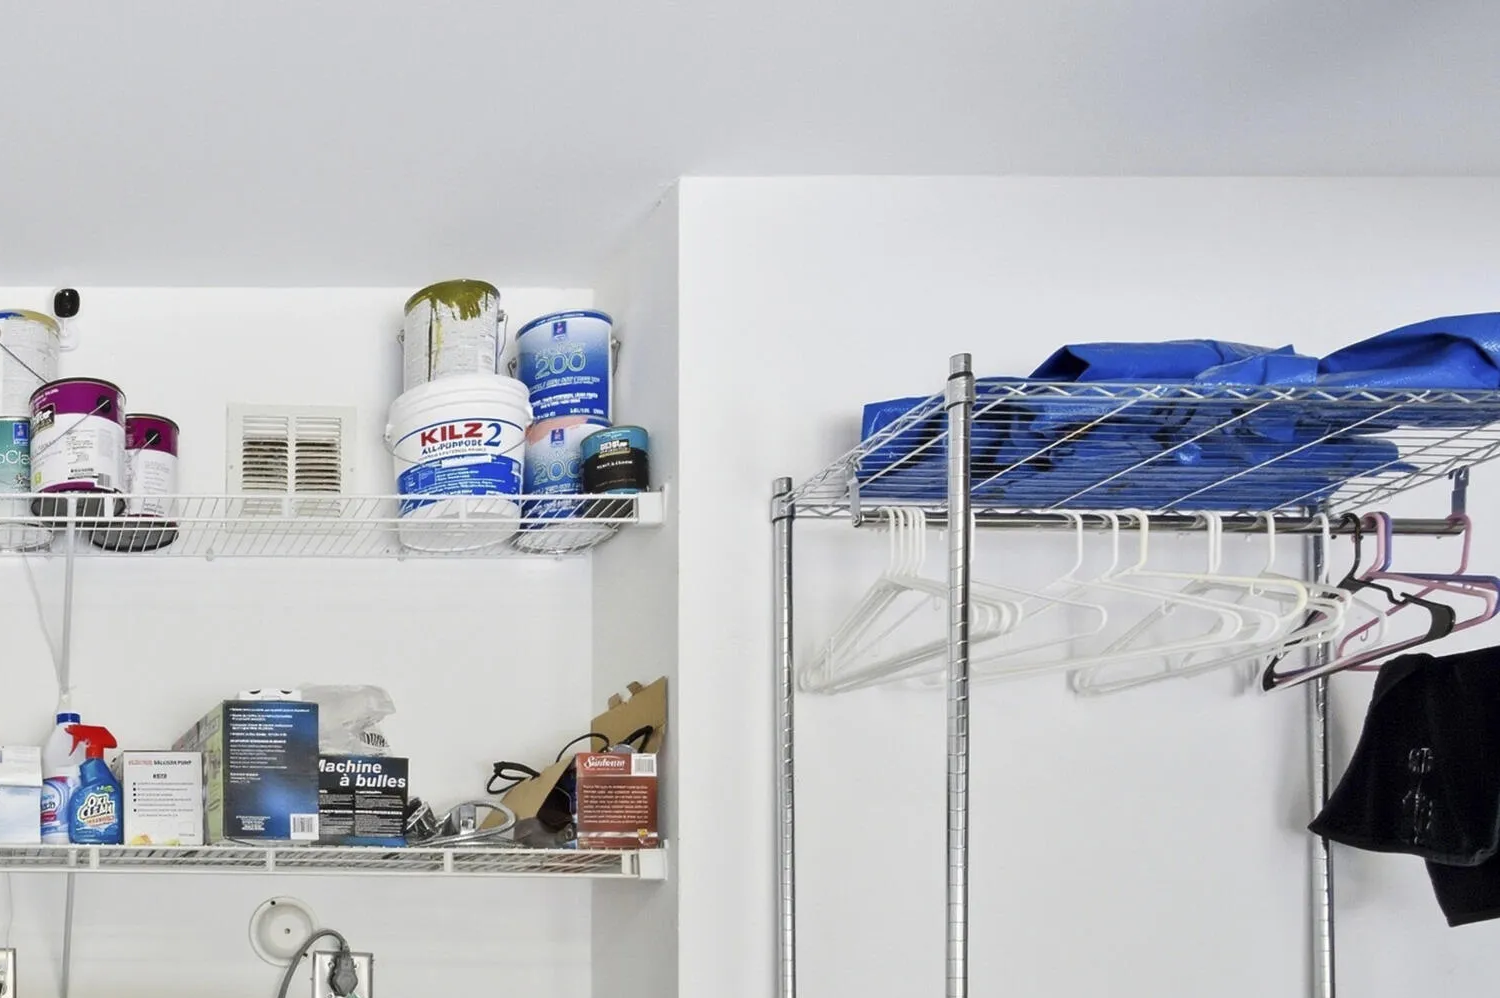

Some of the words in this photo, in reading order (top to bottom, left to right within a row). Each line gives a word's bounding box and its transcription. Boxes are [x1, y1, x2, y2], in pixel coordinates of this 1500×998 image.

[535, 352, 586, 380] 200
[420, 422, 483, 447] KILZ
[484, 422, 503, 447] 2
[339, 773, 350, 787] à
[355, 774, 406, 788] bulles
